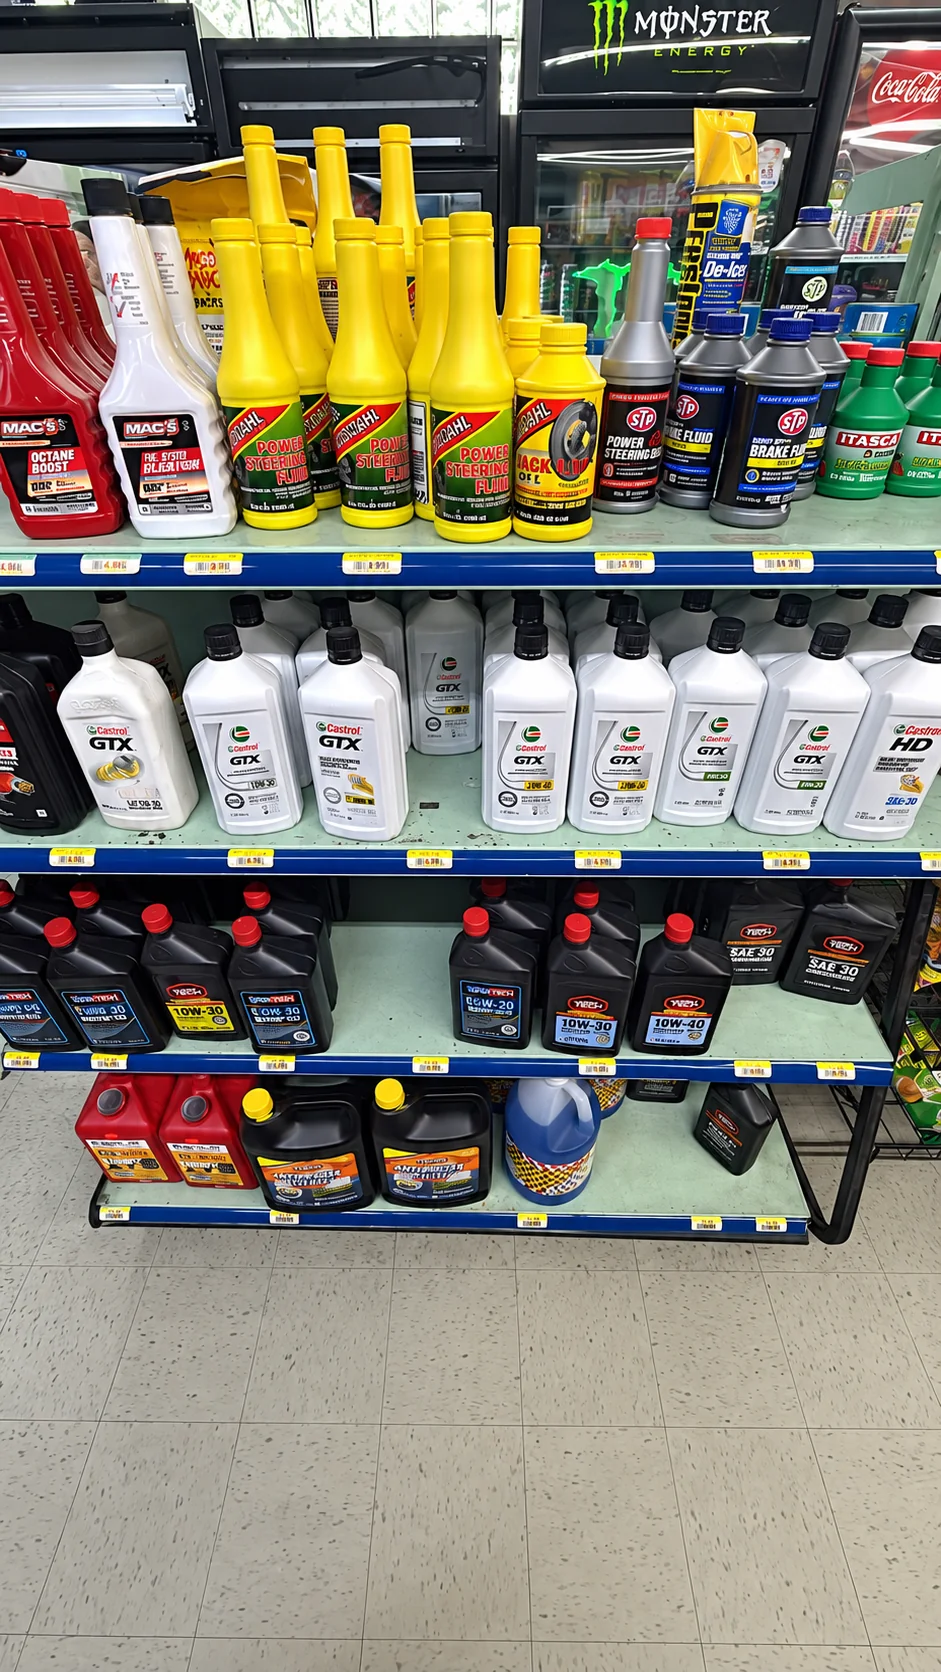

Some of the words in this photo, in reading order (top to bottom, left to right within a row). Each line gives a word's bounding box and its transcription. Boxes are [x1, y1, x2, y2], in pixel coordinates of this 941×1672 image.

[654, 45, 747, 57] ENERGY
[677, 398, 695, 415] STP
[626, 410, 654, 428] STP
[782, 412, 805, 431] STP
[3, 419, 56, 433] MAC'S
[126, 420, 176, 434] MAC'S
[607, 436, 645, 448] POWER
[683, 430, 713, 444] FLUID
[840, 433, 898, 446] ITASCA
[31, 449, 75, 462] OCTANE
[605, 448, 650, 460] STEERING
[749, 444, 790, 458] BRAKE
[31, 461, 68, 474] BOOST
[436, 683, 461, 692] GTX
[97, 726, 130, 736] Castrol
[327, 723, 361, 735] Castrol
[89, 736, 134, 751] GTX
[318, 735, 362, 751] GTX
[888, 737, 933, 752] HD
[697, 746, 728, 756] GTX
[230, 754, 261, 766] GTX
[513, 755, 544, 765] GTX
[609, 756, 641, 765] GTX
[793, 755, 826, 765] GTX
[730, 948, 755, 957] SAE
[808, 958, 837, 972] SAE
[839, 965, 859, 977] 30
[173, 1006, 224, 1016] 10W-30
[561, 1019, 612, 1031] 10W-30
[655, 1018, 705, 1029] 10W-40
